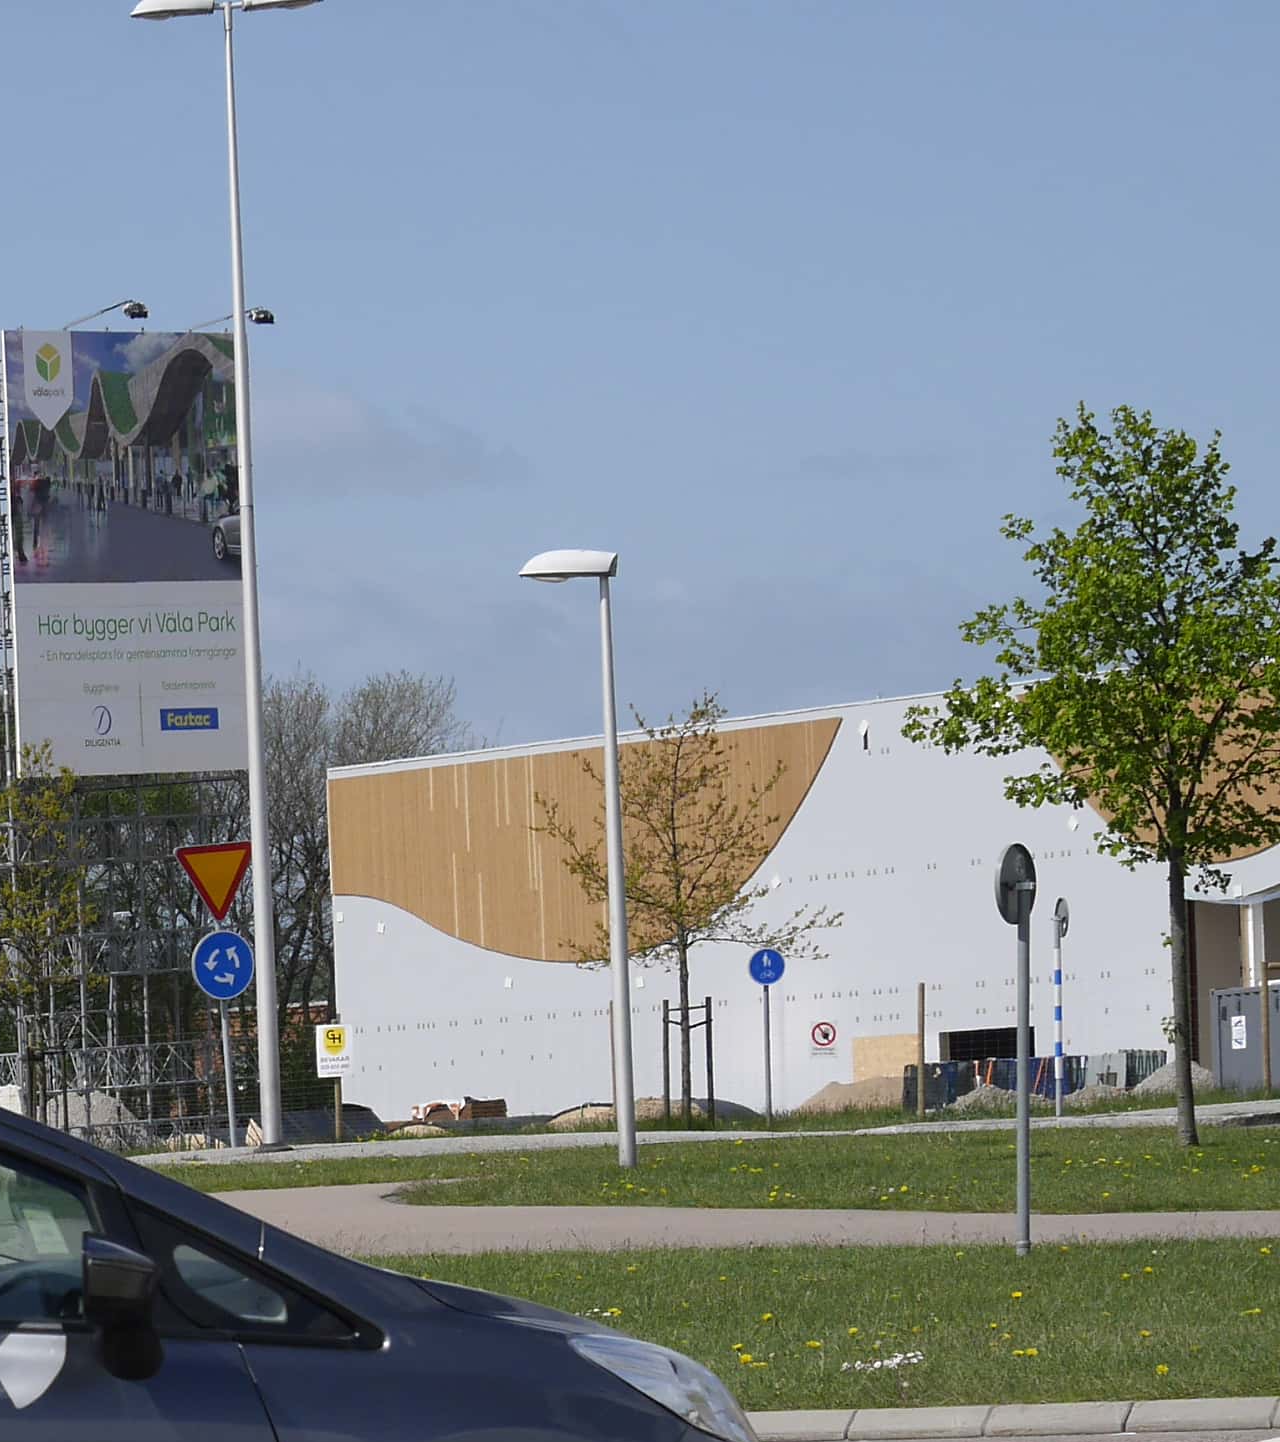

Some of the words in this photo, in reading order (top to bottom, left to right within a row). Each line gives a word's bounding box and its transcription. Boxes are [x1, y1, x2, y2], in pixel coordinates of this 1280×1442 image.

[37, 614, 69, 636] Här
[72, 612, 135, 642] bygger
[139, 614, 152, 634] vi
[155, 610, 193, 633] Väla
[197, 608, 237, 633] Park
